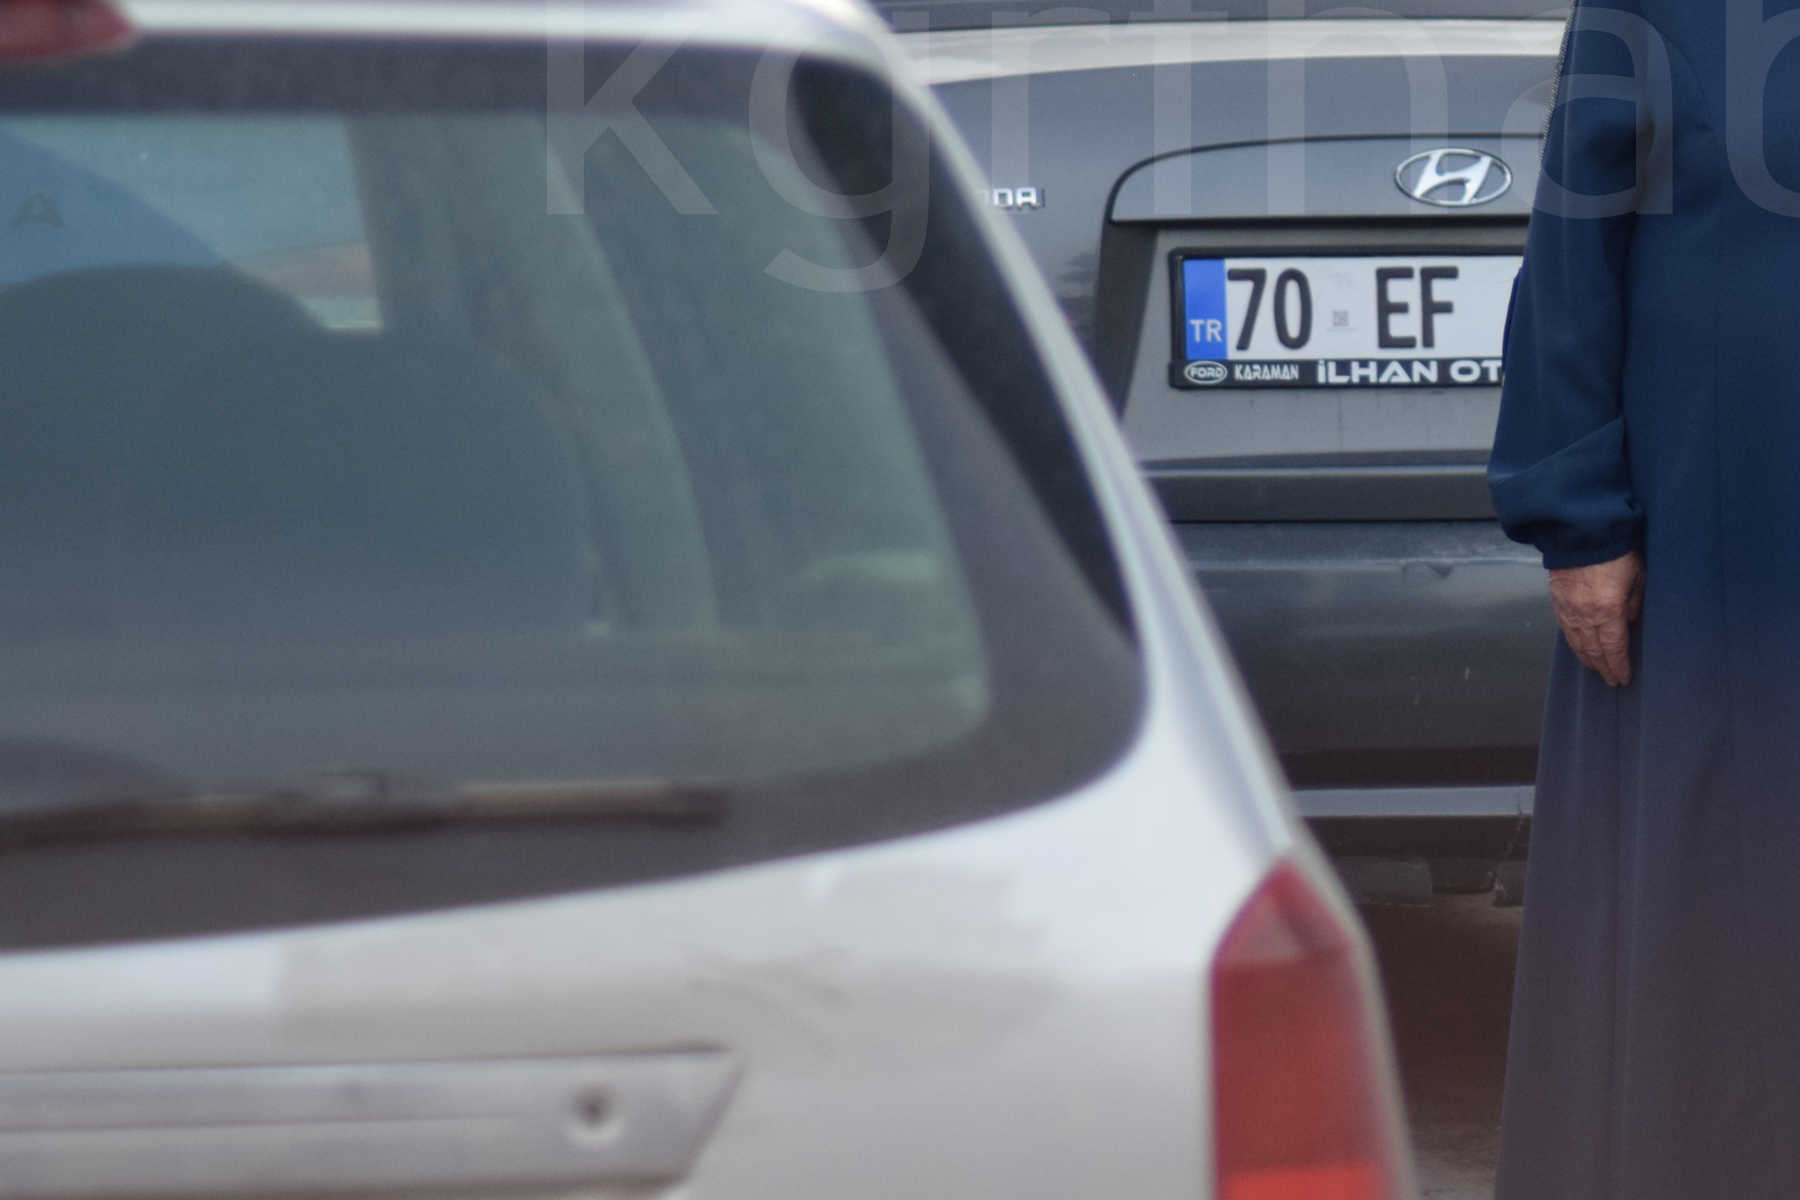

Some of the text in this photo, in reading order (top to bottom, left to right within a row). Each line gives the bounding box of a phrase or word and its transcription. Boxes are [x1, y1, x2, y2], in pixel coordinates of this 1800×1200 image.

[1227, 266, 1459, 351] 70 EF
[1190, 319, 1223, 343] TR
[1189, 366, 1225, 379] FORD
[1234, 364, 1299, 380] KARAMAN
[1450, 359, 1505, 383] OT
